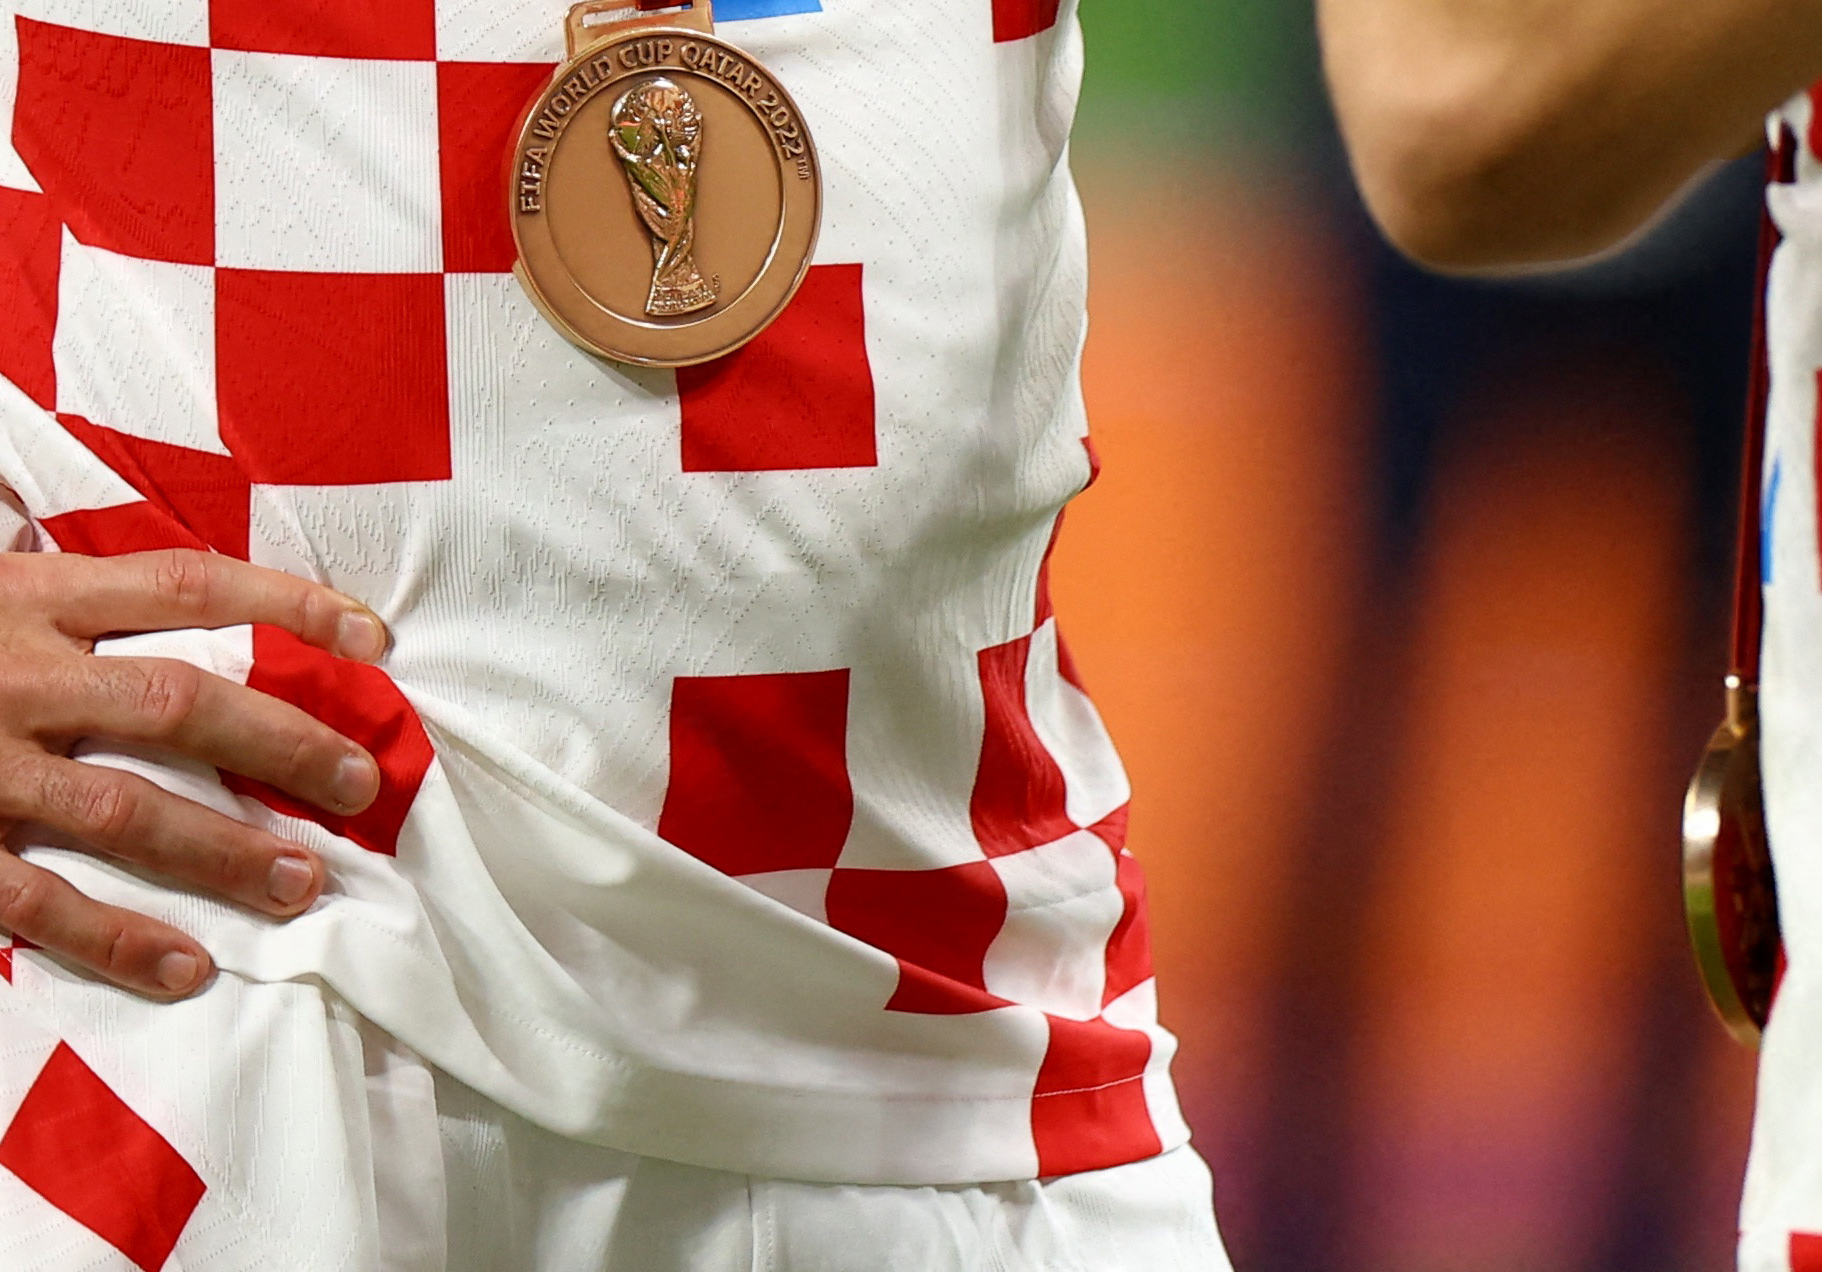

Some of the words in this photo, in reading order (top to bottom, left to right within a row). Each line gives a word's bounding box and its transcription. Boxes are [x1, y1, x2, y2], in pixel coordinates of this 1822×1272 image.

[619, 38, 674, 69] CUP
[680, 40, 763, 99] QATAR
[533, 55, 613, 140] WORLD
[520, 147, 548, 212] FIFA
